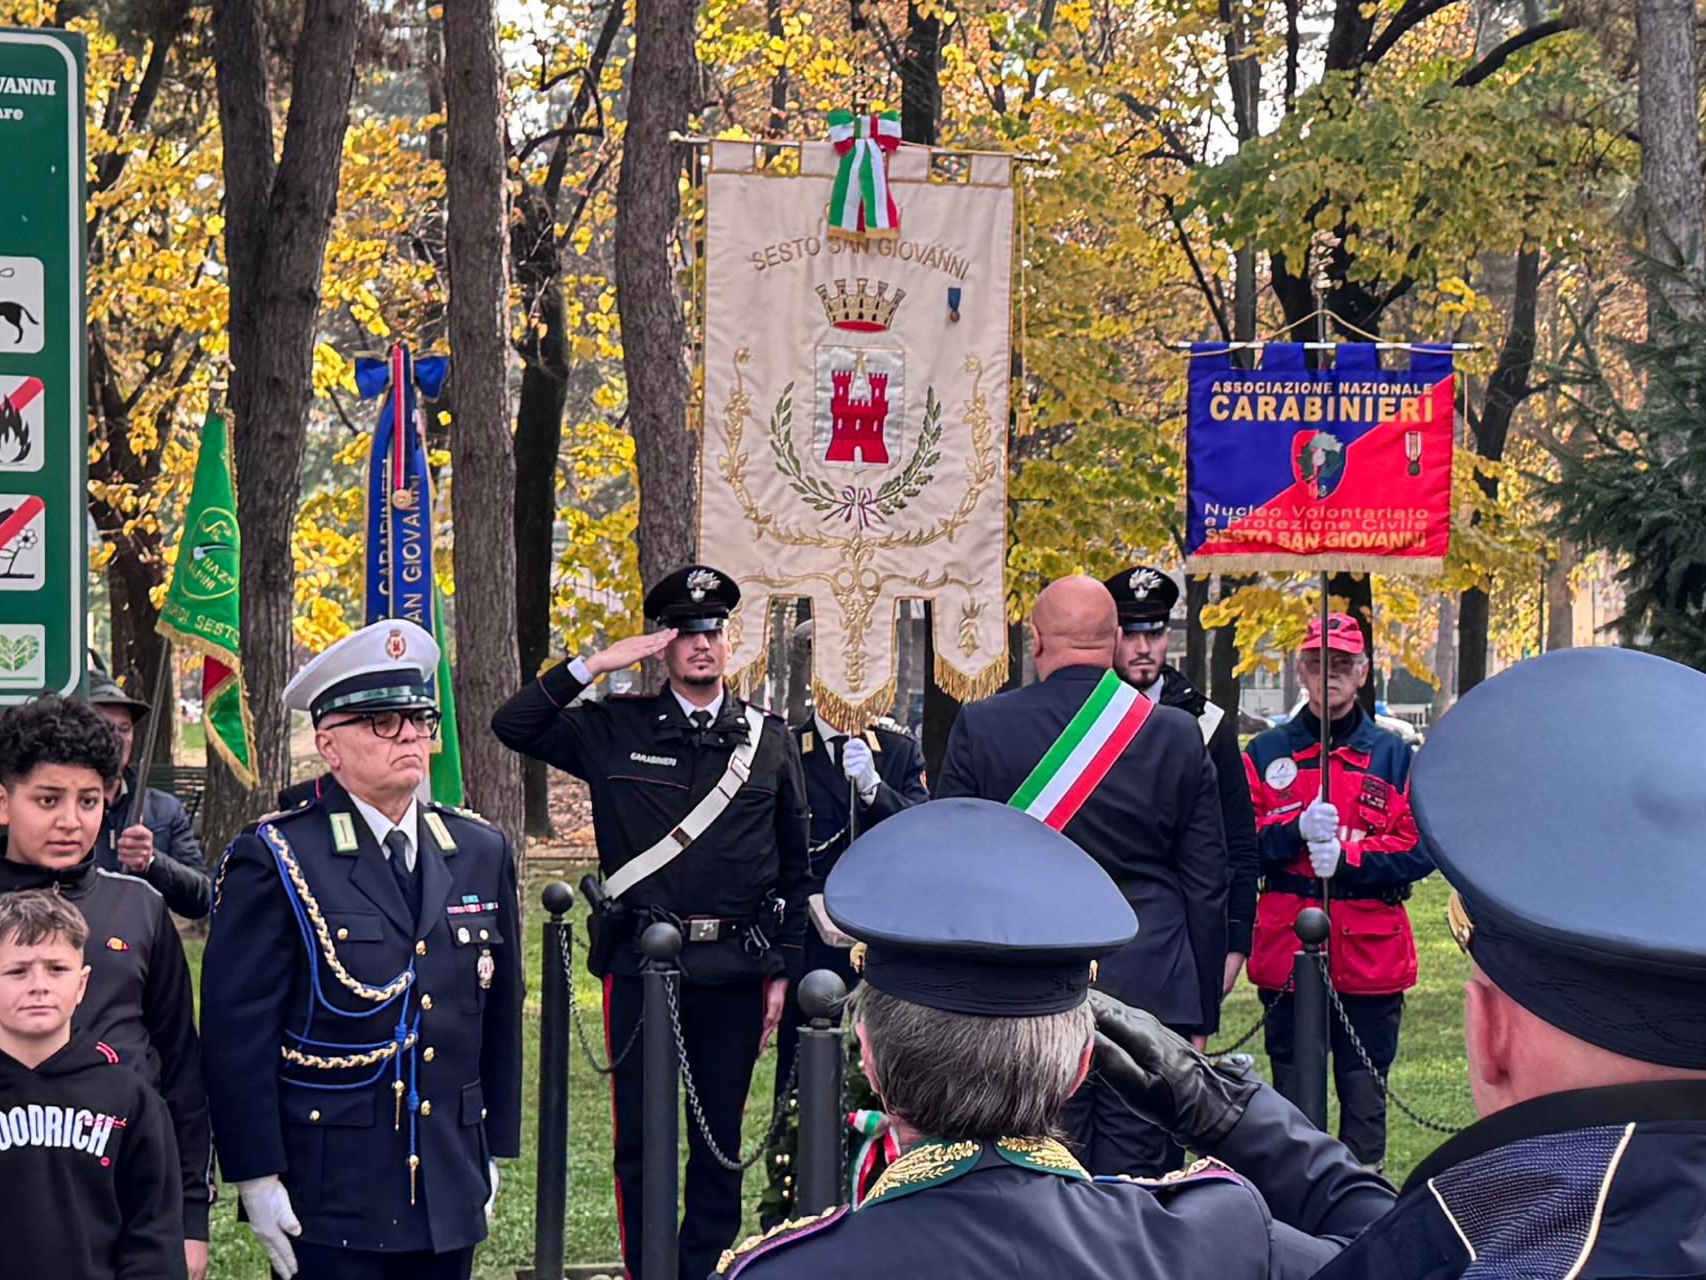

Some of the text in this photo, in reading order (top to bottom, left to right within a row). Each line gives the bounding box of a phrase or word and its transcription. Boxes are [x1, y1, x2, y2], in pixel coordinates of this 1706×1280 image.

[751, 236, 970, 280] SESTO SAN GIOVANNI
[1211, 381, 1433, 395] ASSOCIAZIONE NAZIONALE
[1210, 395, 1433, 423] CARABINIERI
[1205, 503, 1429, 520] Nucleo Volontariato
[1204, 517, 1427, 531] e Protezione Civile
[1205, 529, 1427, 552] SESTO SAN GIOVANNI
